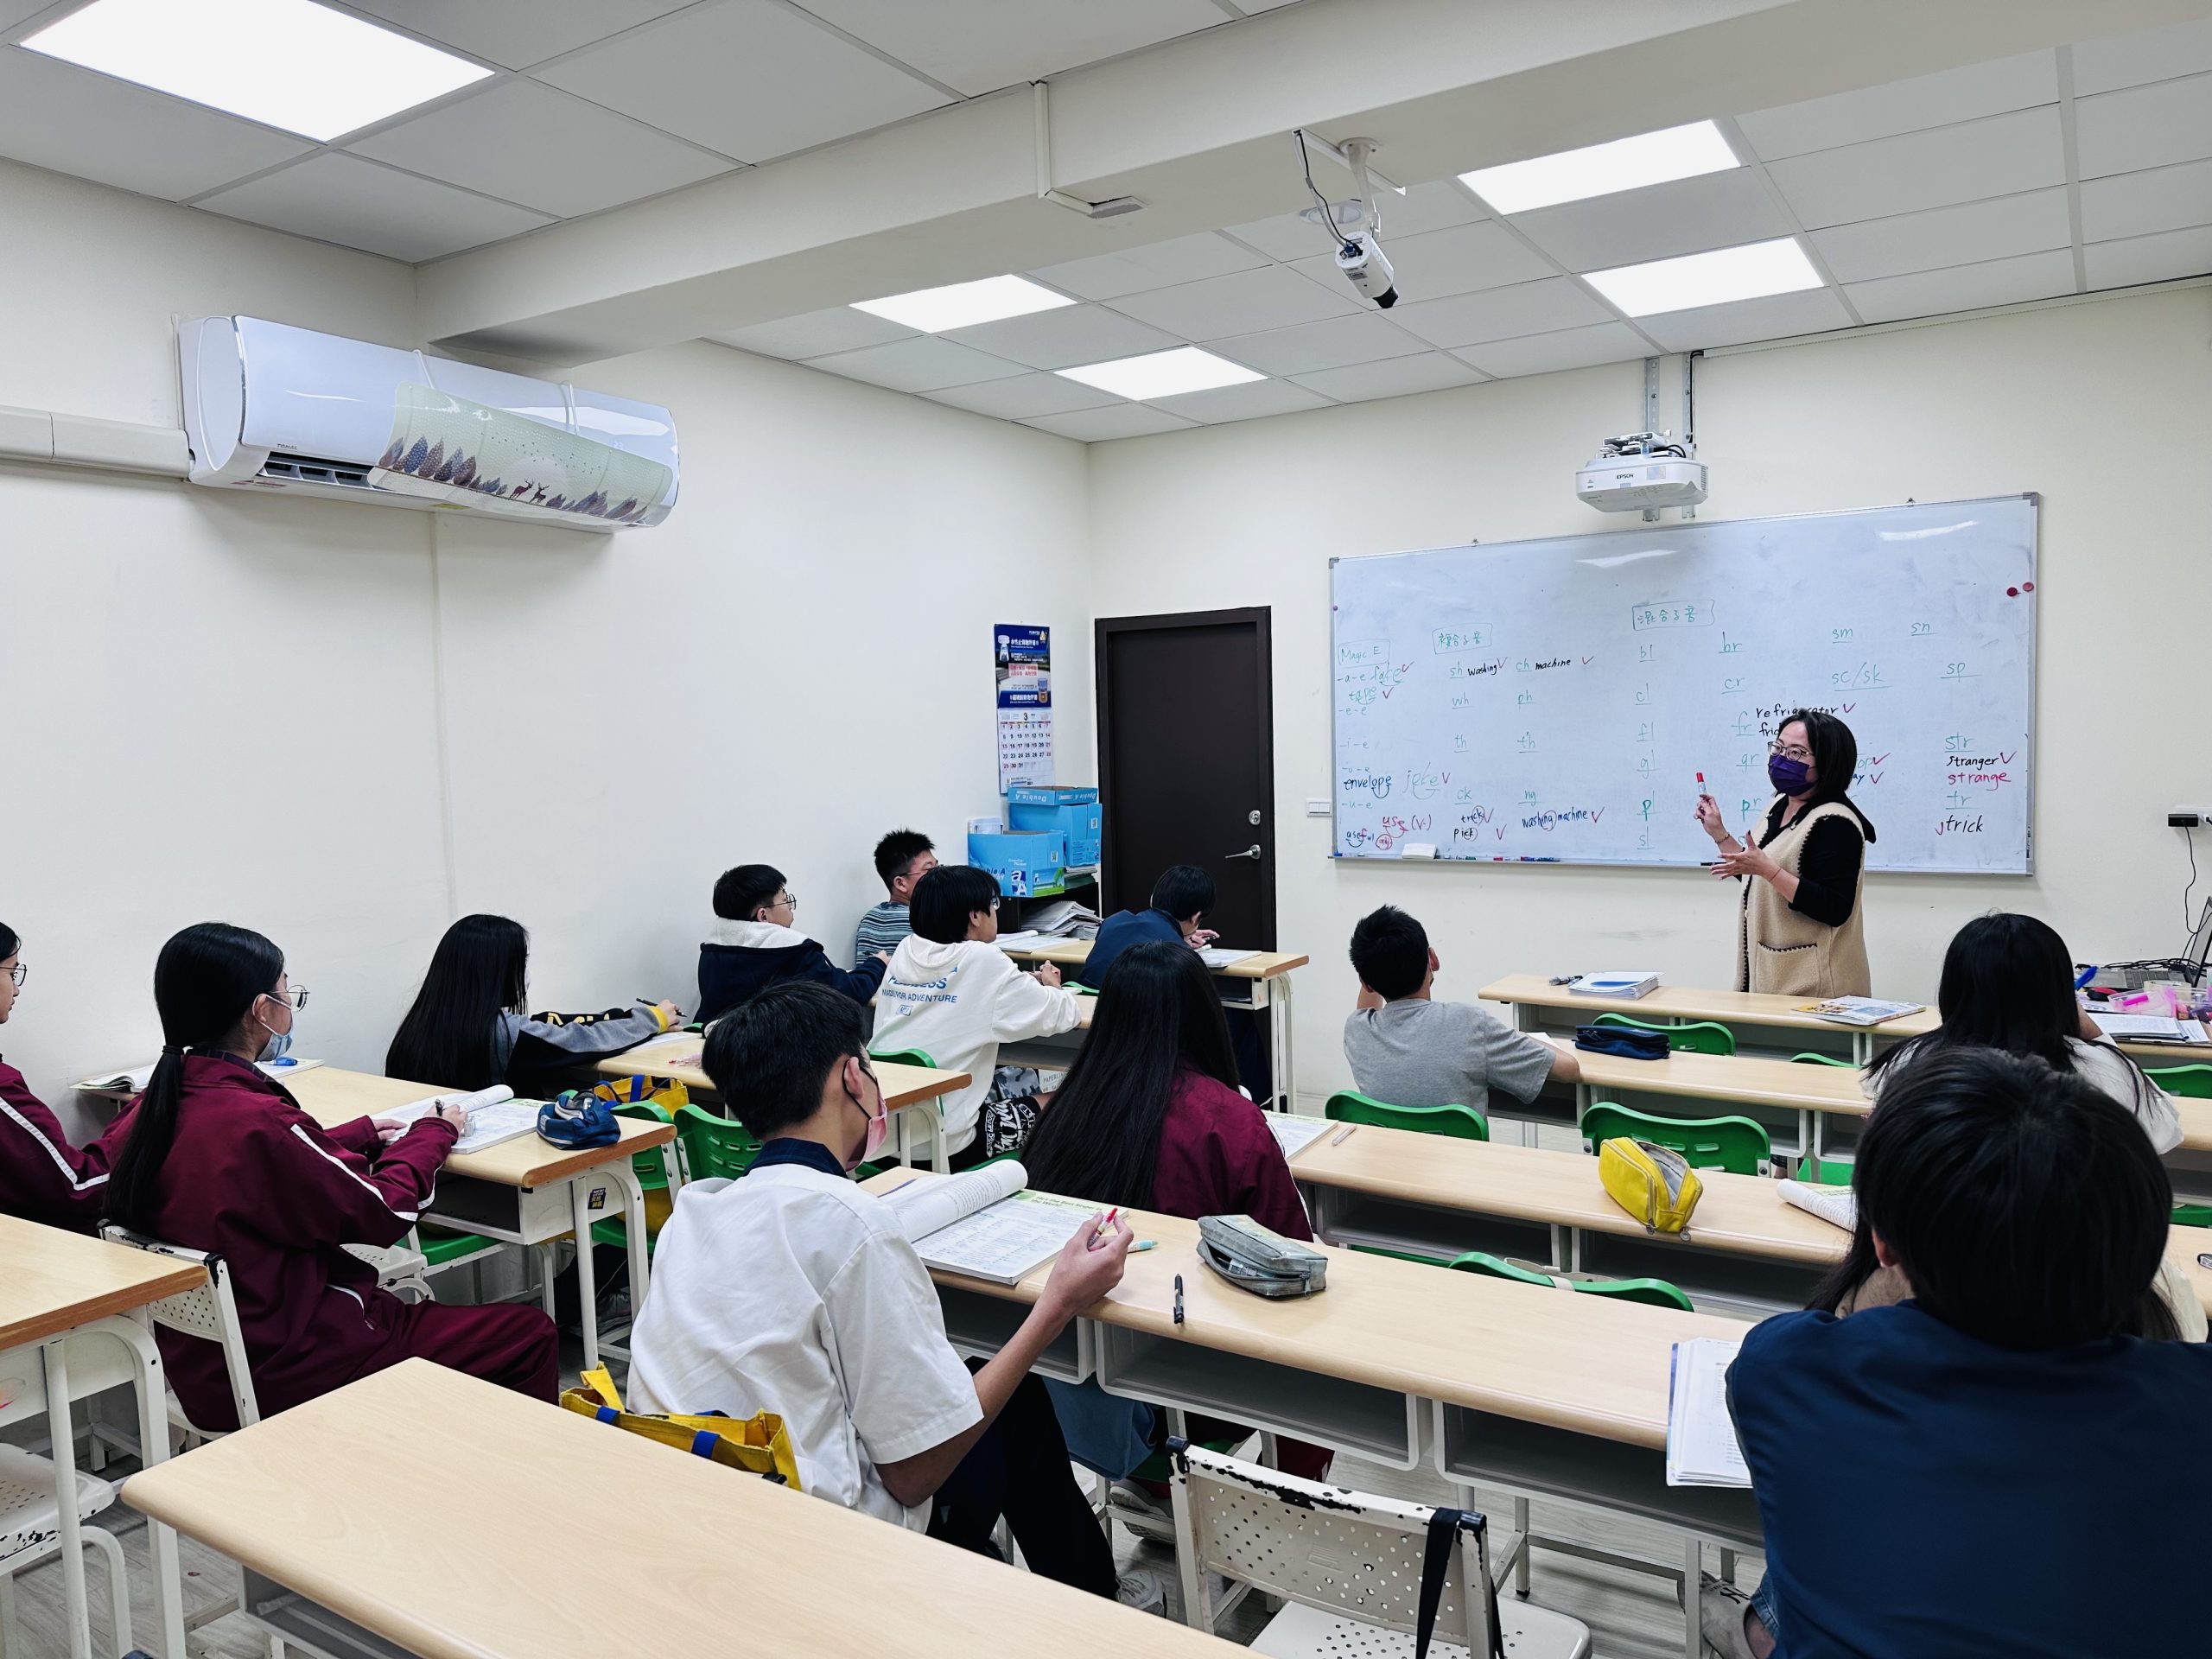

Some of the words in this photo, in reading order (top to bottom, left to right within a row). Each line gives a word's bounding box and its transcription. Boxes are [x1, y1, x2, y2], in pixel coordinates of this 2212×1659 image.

[1833, 628, 1853, 639] sm
[1910, 622, 1930, 633] sn
[1341, 648, 1367, 663] Magic
[1373, 646, 1382, 655] E
[1450, 661, 1463, 676] sh
[1516, 658, 1530, 670] ch
[1535, 658, 1572, 671] machine
[1946, 662, 1966, 683] sp
[1724, 677, 1745, 690] cr
[1452, 691, 1470, 707] wh
[1517, 690, 1533, 710] ph
[1023, 712, 1028, 721] 3
[1454, 734, 1467, 749] th
[1344, 775, 1392, 795] envelope
[1948, 772, 2012, 791] strange
[1457, 787, 1472, 801] ck
[1382, 816, 1406, 830] use
[1522, 811, 1554, 829] washing
[1557, 806, 1589, 821] machine
[1946, 814, 1984, 833] trick
[908, 994, 957, 1003] ADVENTURE
